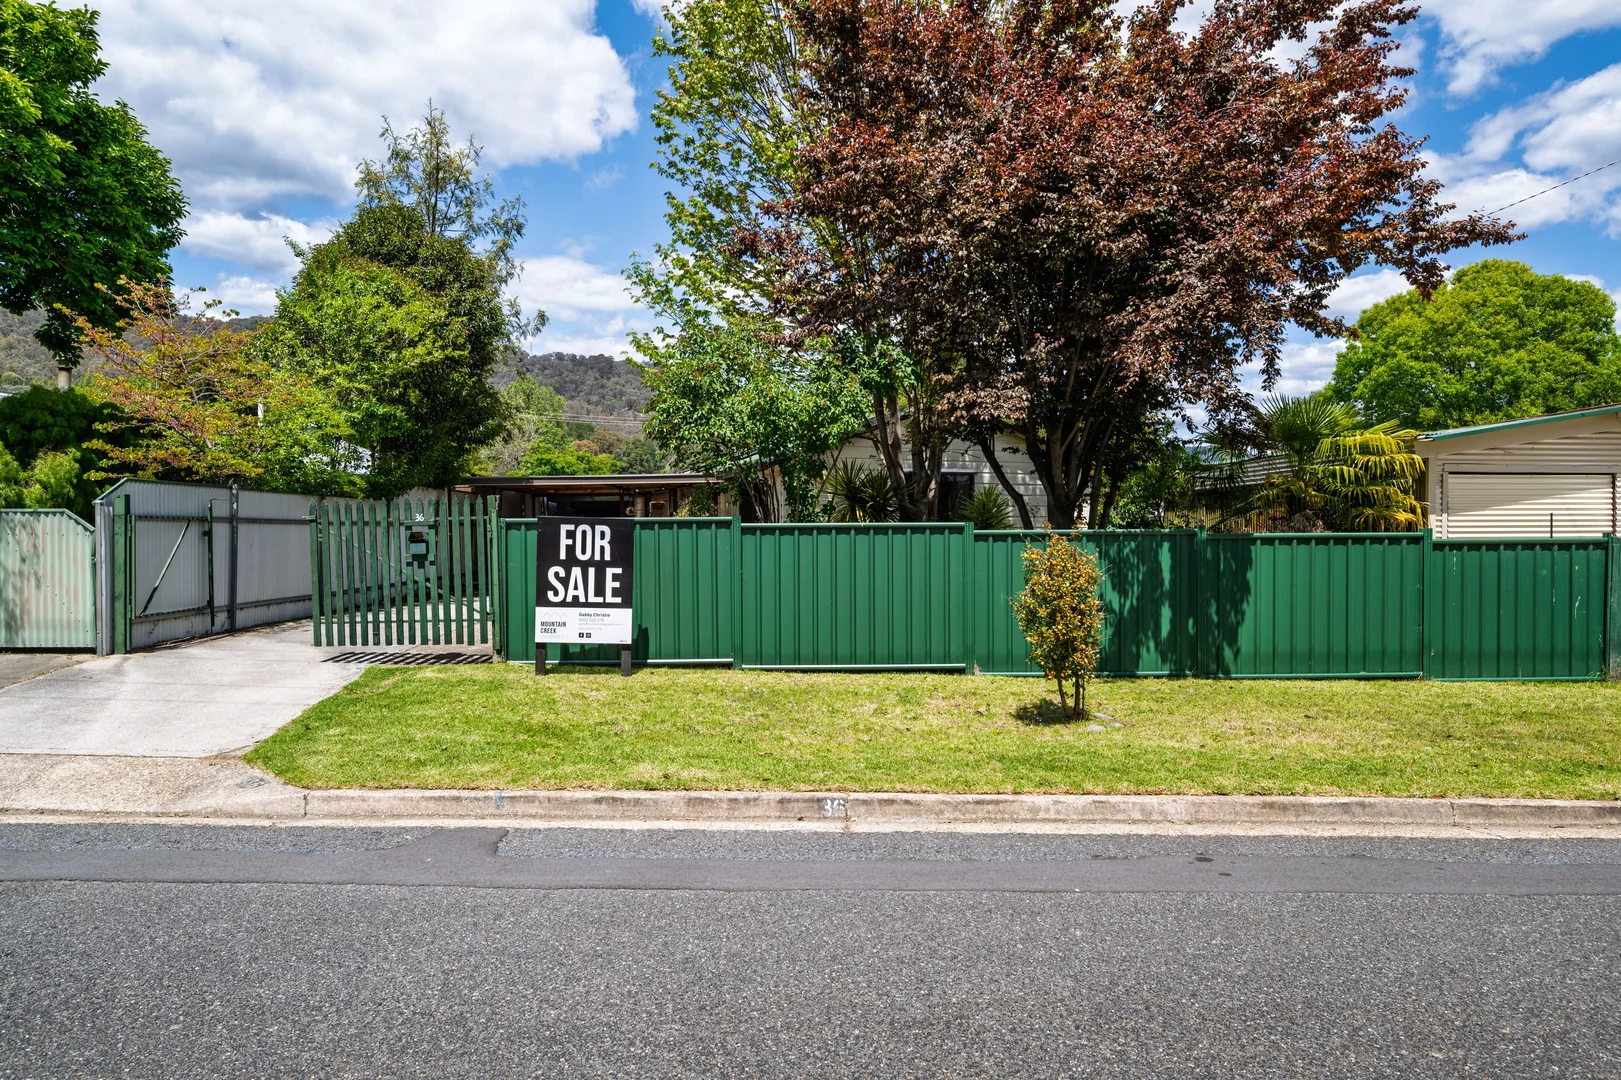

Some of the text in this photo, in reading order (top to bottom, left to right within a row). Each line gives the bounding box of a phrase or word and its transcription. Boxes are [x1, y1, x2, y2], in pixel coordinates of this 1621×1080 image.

[415, 513, 424, 521] 36
[559, 524, 611, 561] FOR
[547, 566, 622, 603] SALE
